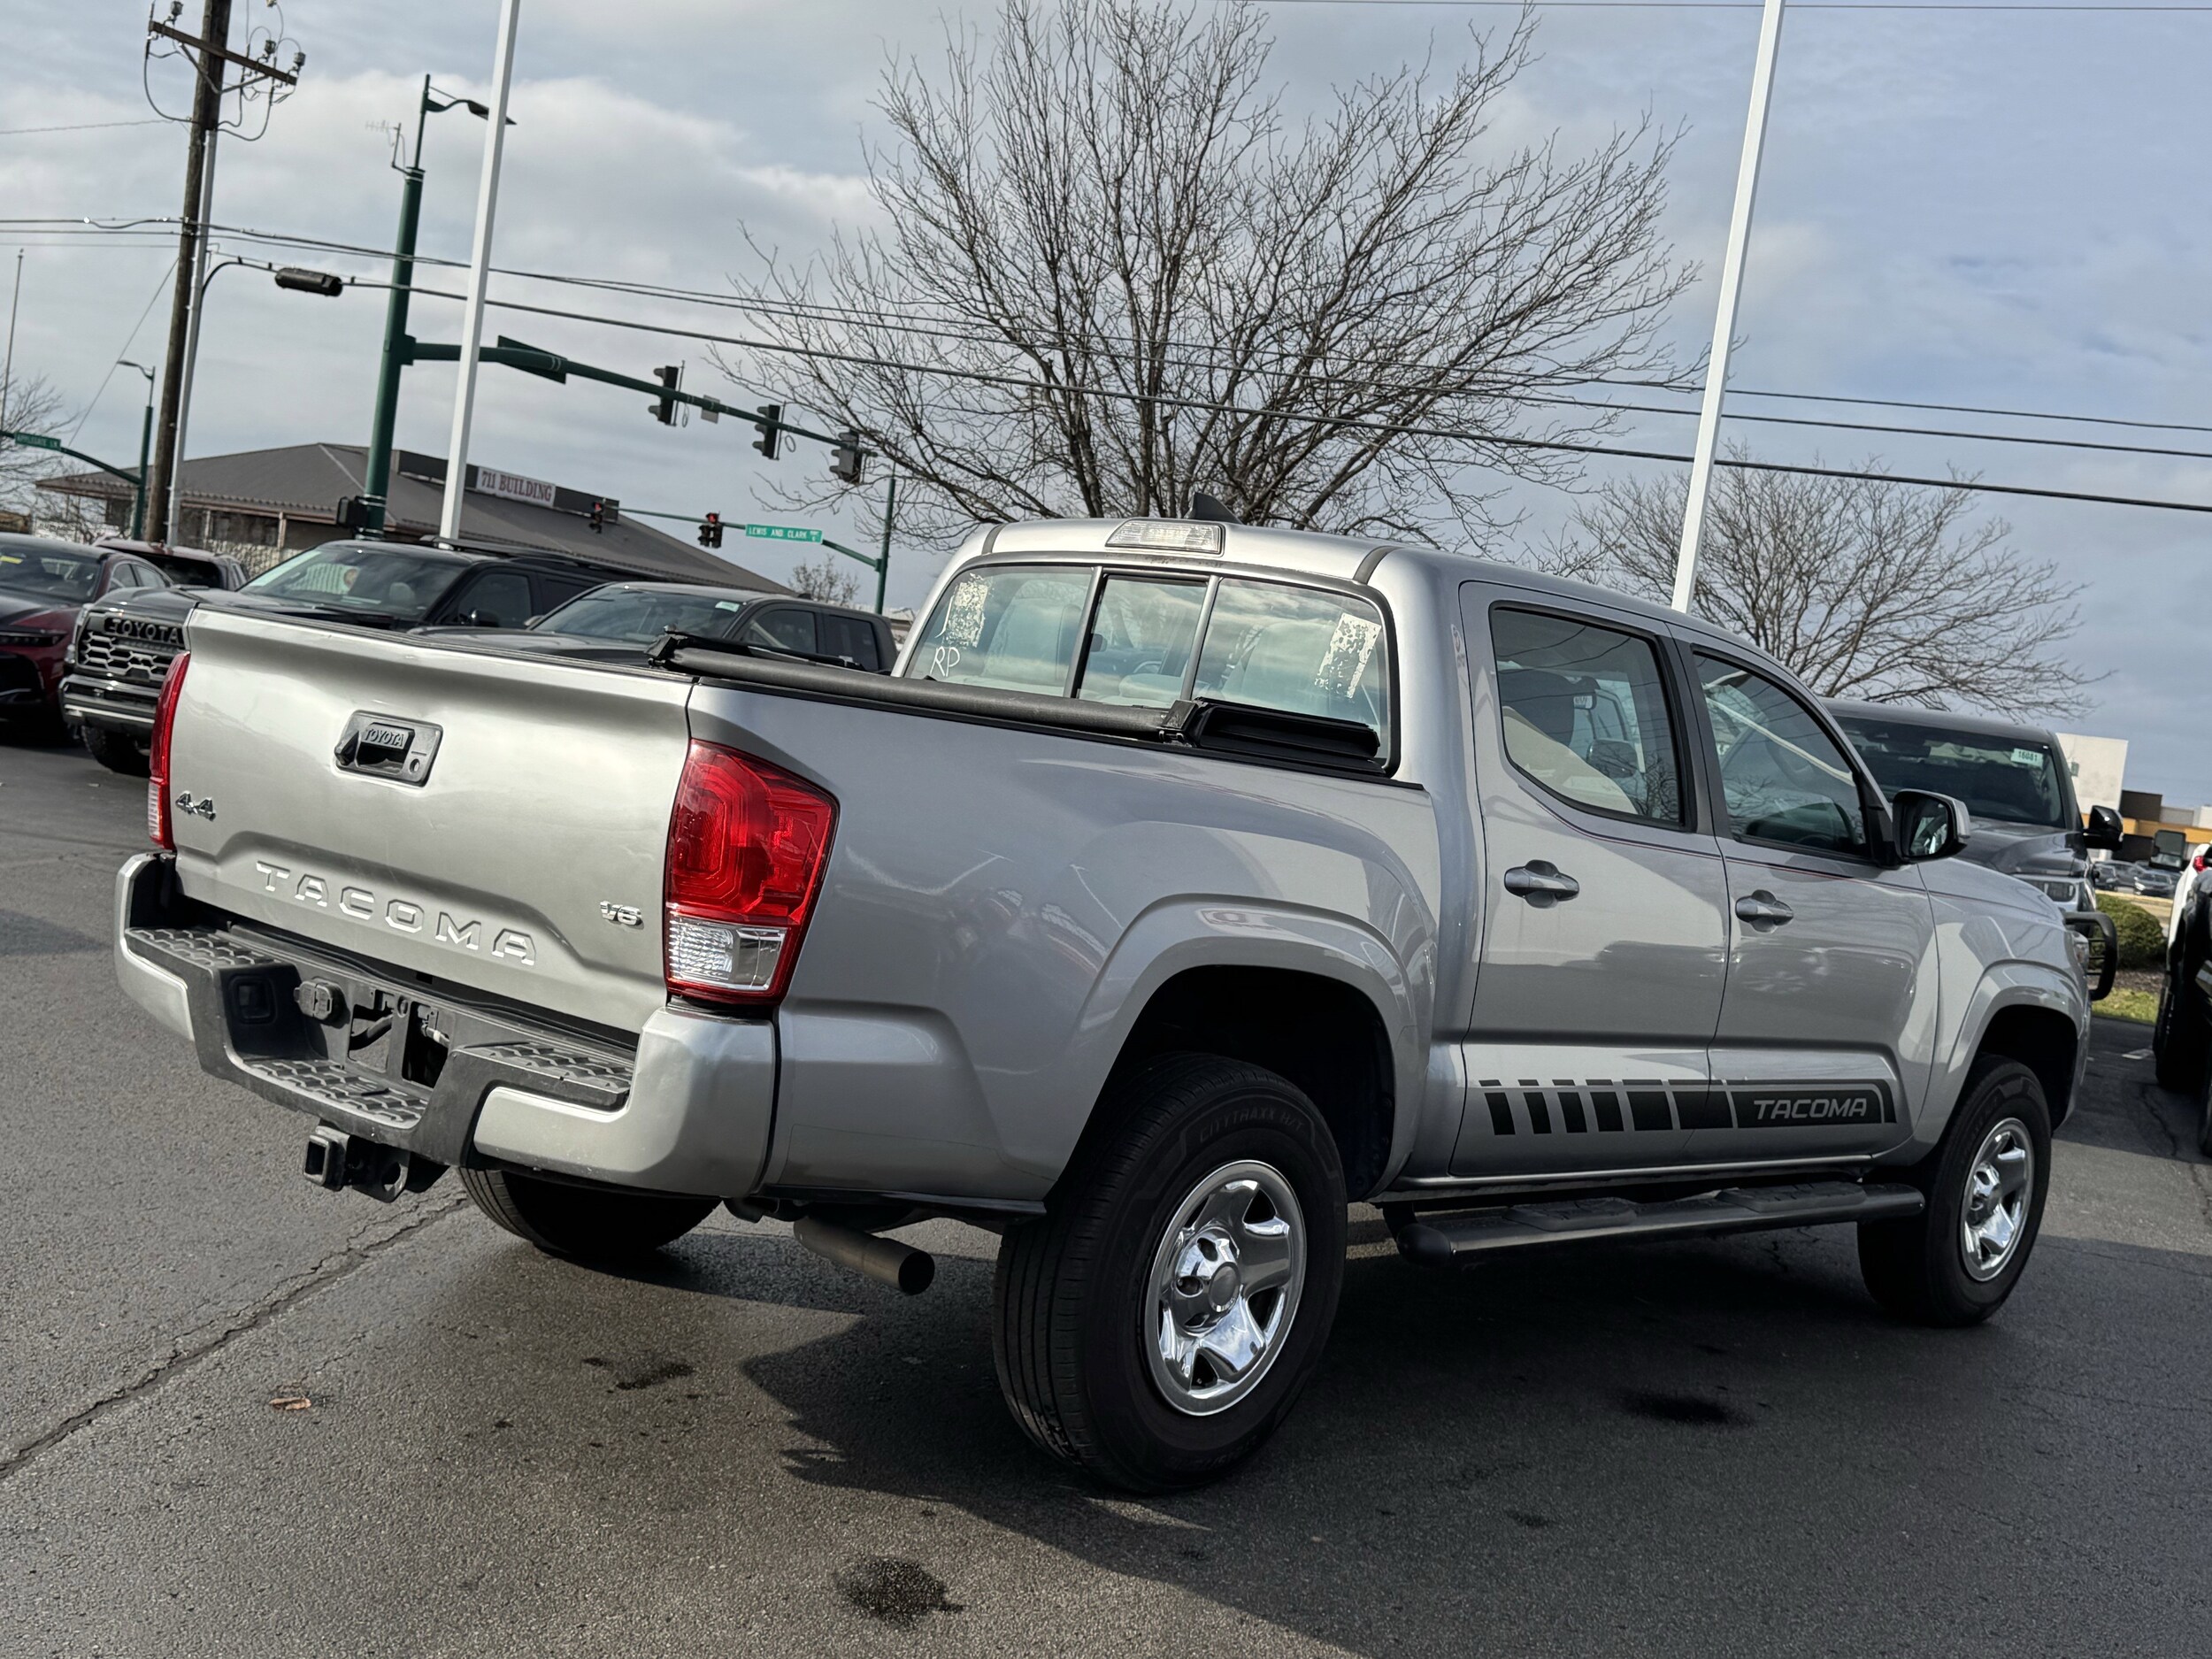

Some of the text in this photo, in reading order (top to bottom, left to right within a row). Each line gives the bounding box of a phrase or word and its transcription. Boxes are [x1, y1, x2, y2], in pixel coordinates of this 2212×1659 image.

[481, 470, 553, 502] 711 BUILDING
[749, 526, 768, 535] LEWIS
[771, 528, 784, 537] AND
[787, 530, 807, 539] CLARK
[110, 618, 180, 645] TOYOTA
[929, 645, 961, 677] RP
[365, 727, 404, 748] TOYOTA
[256, 860, 537, 966] TACOMA
[600, 900, 643, 929] V6
[1754, 1097, 1867, 1120] TACOMA
